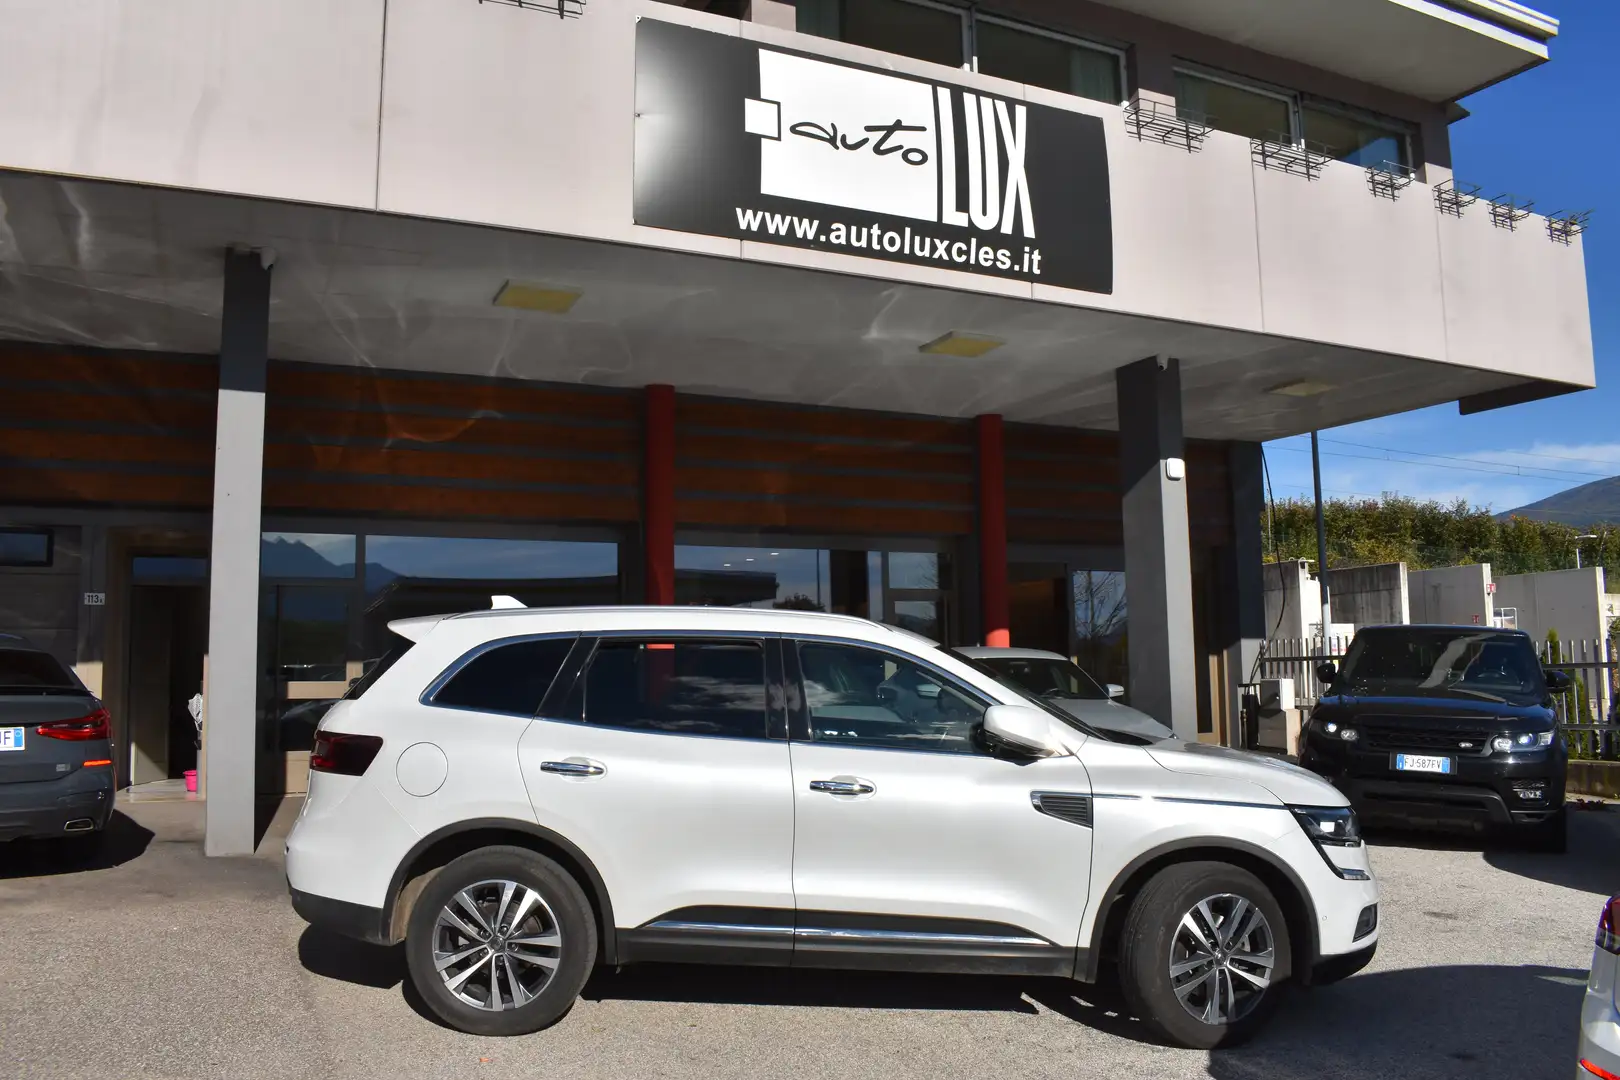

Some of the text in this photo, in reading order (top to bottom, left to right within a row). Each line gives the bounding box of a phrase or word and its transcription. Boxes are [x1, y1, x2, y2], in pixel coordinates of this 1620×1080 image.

[789, 86, 1036, 239] auto LUX
[735, 207, 1042, 275] www.autoluxcles.it
[0, 731, 11, 745] F
